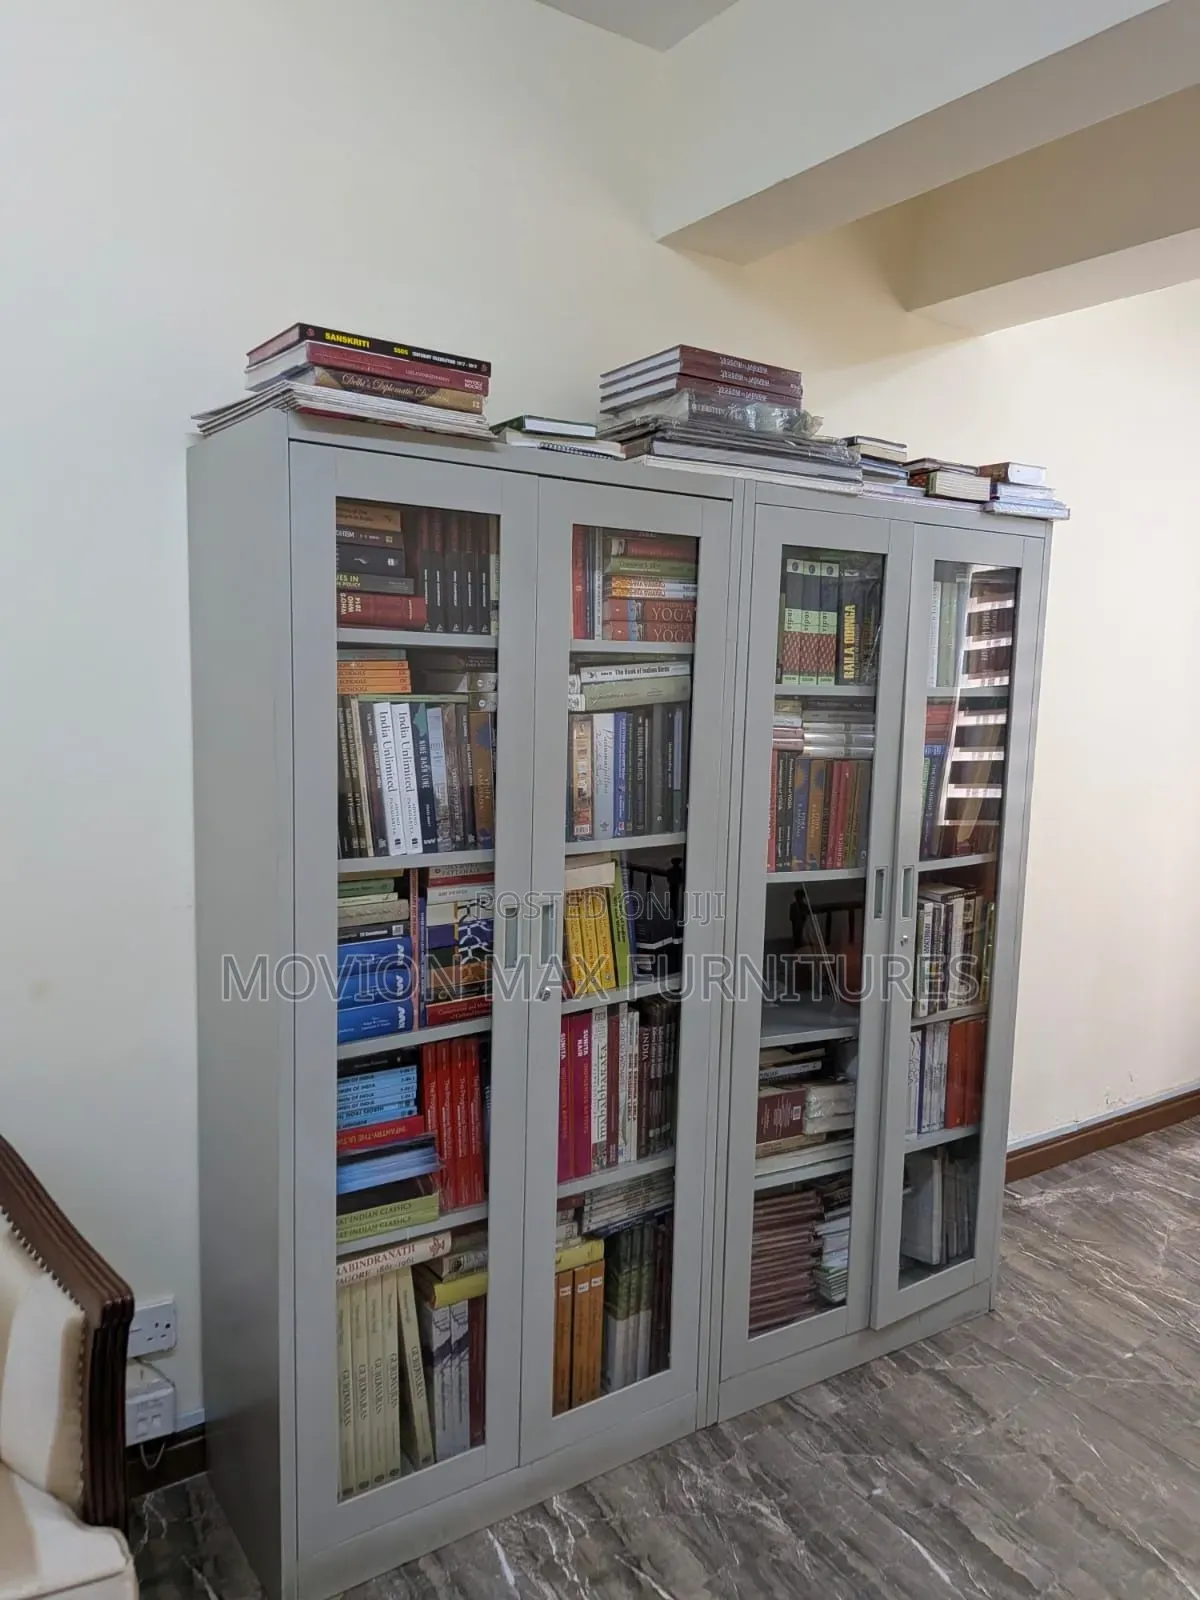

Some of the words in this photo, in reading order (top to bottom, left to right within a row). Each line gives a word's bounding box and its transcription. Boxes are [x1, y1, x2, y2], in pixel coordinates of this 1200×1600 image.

[325, 332, 369, 348] SANSKRITI
[653, 608, 692, 622] YOGA
[844, 604, 856, 644] ODINGA
[844, 648, 855, 679] RAILA
[379, 711, 391, 741] India
[398, 712, 411, 741] India
[383, 741, 398, 793] Unlimited
[401, 742, 415, 793] Unlimited
[350, 1211, 378, 1223] INDIAN
[380, 1202, 412, 1216] CLASSICS
[337, 1244, 415, 1276] RABINDRANATH
